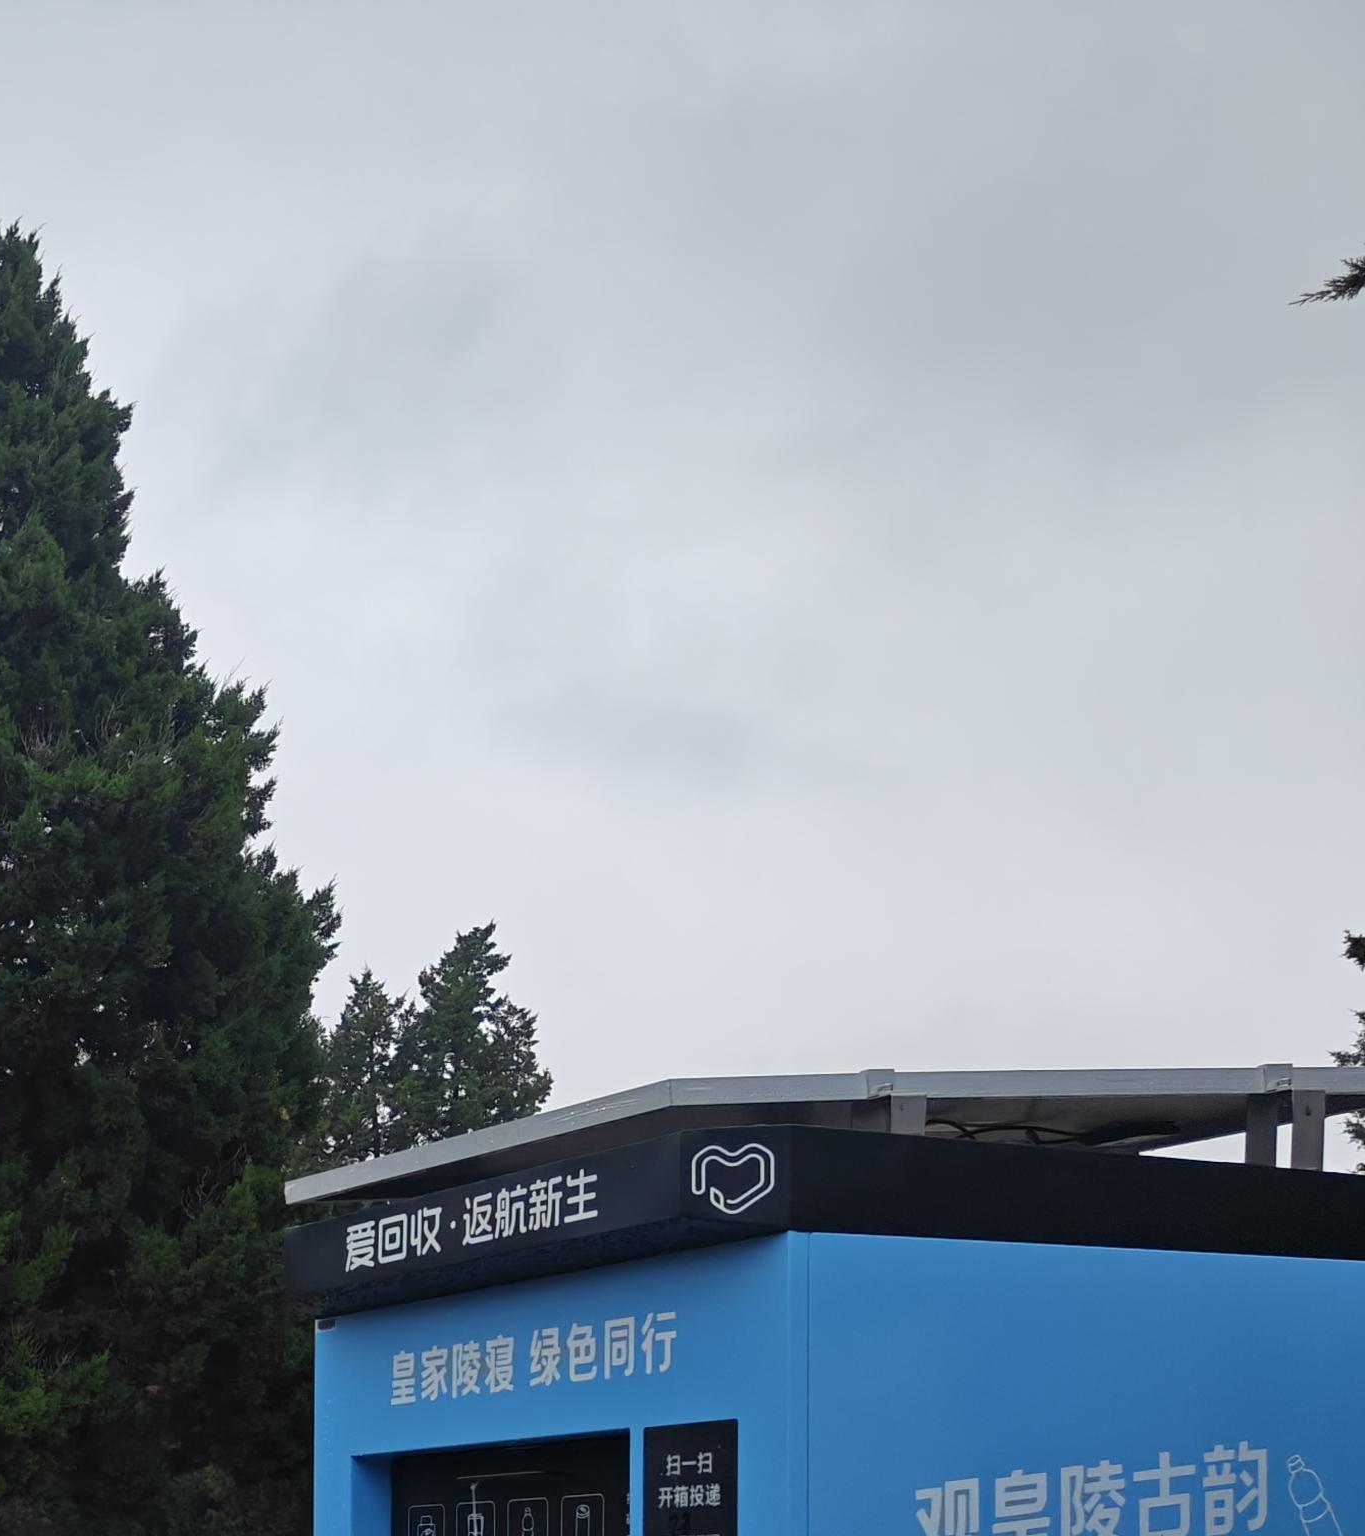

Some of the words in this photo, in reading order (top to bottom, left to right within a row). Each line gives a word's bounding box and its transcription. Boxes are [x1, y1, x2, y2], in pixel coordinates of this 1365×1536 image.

[345, 1168, 599, 1273] 爱回收·返航新生
[390, 1333, 515, 1407] 皇家陵寝
[528, 1310, 678, 1388] 绿色同行
[665, 1451, 713, 1476] 扫一扫
[657, 1482, 722, 1509] 开箱投递
